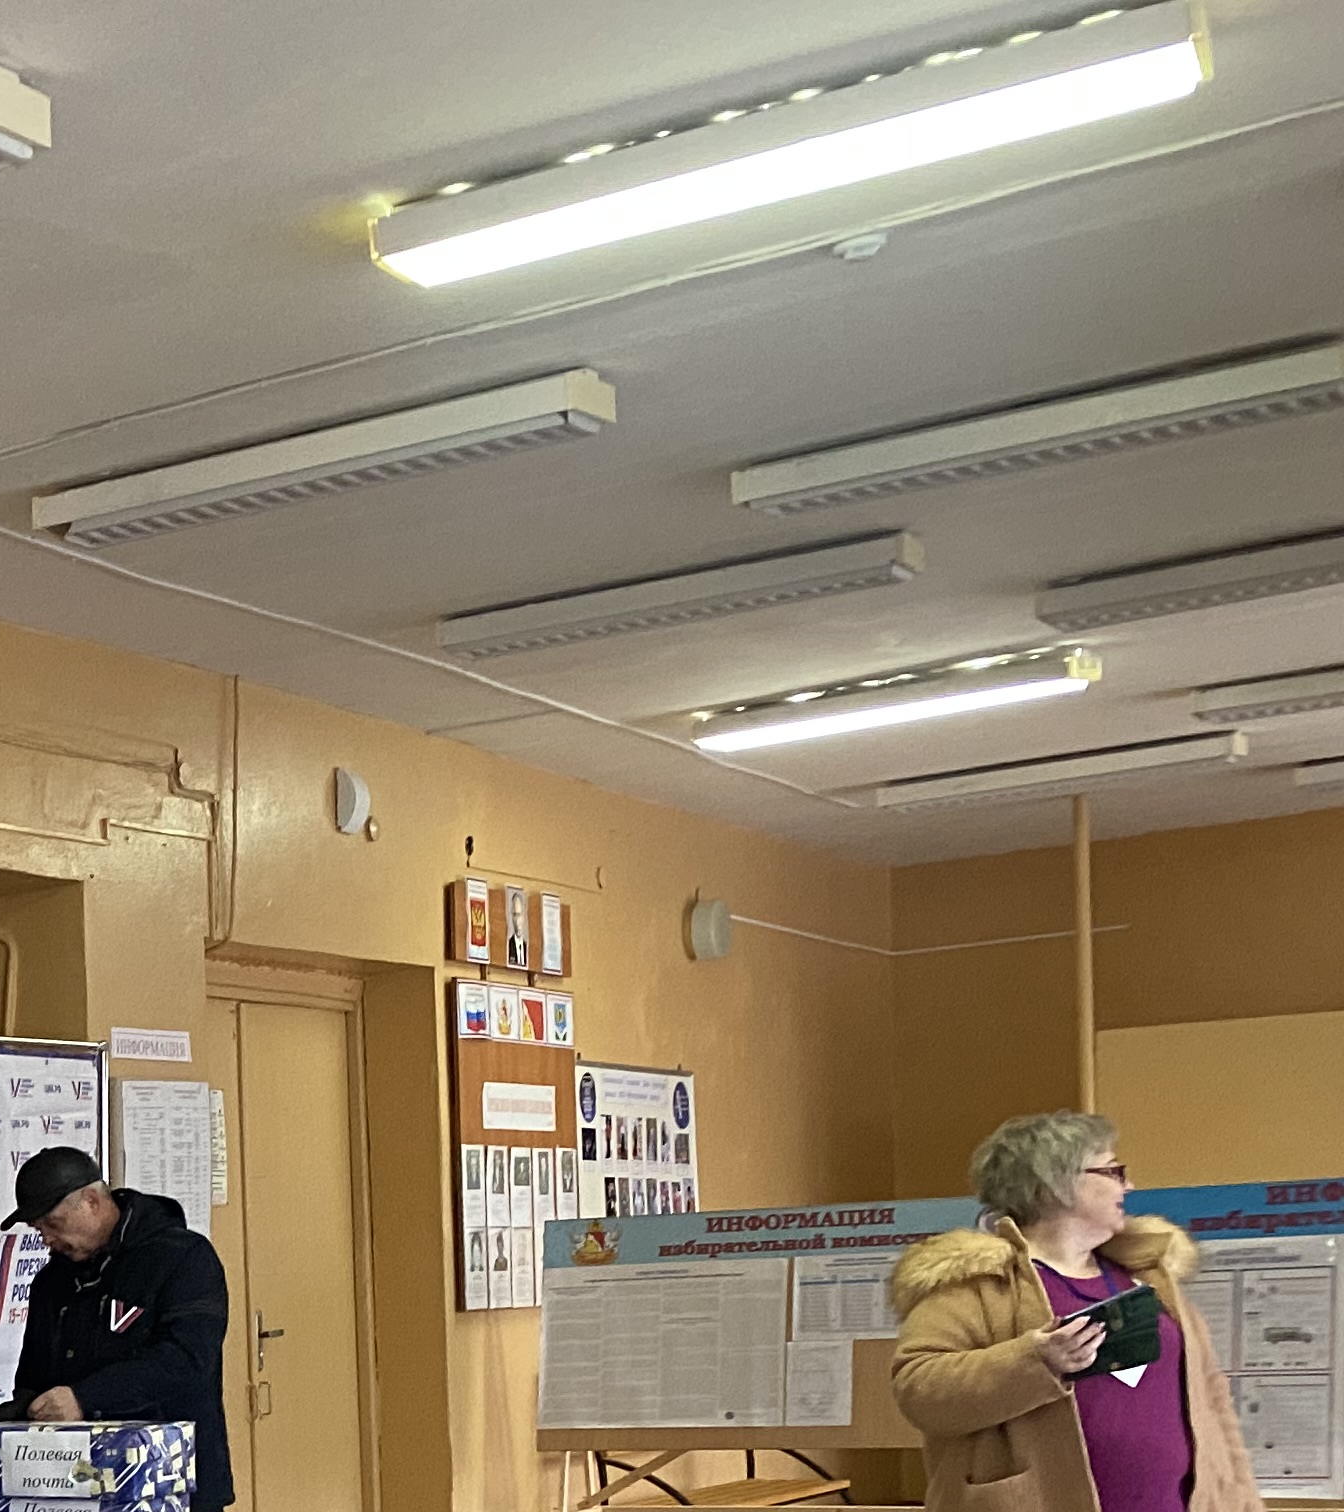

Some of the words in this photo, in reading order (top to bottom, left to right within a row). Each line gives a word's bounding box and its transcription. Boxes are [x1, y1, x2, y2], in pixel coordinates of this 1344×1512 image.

[705, 1207, 896, 1233] ИНФОРМАЦИЯ
[658, 1233, 826, 1258] избирательной
[14, 1444, 82, 1462] Полевая
[22, 1473, 75, 1489] почта
